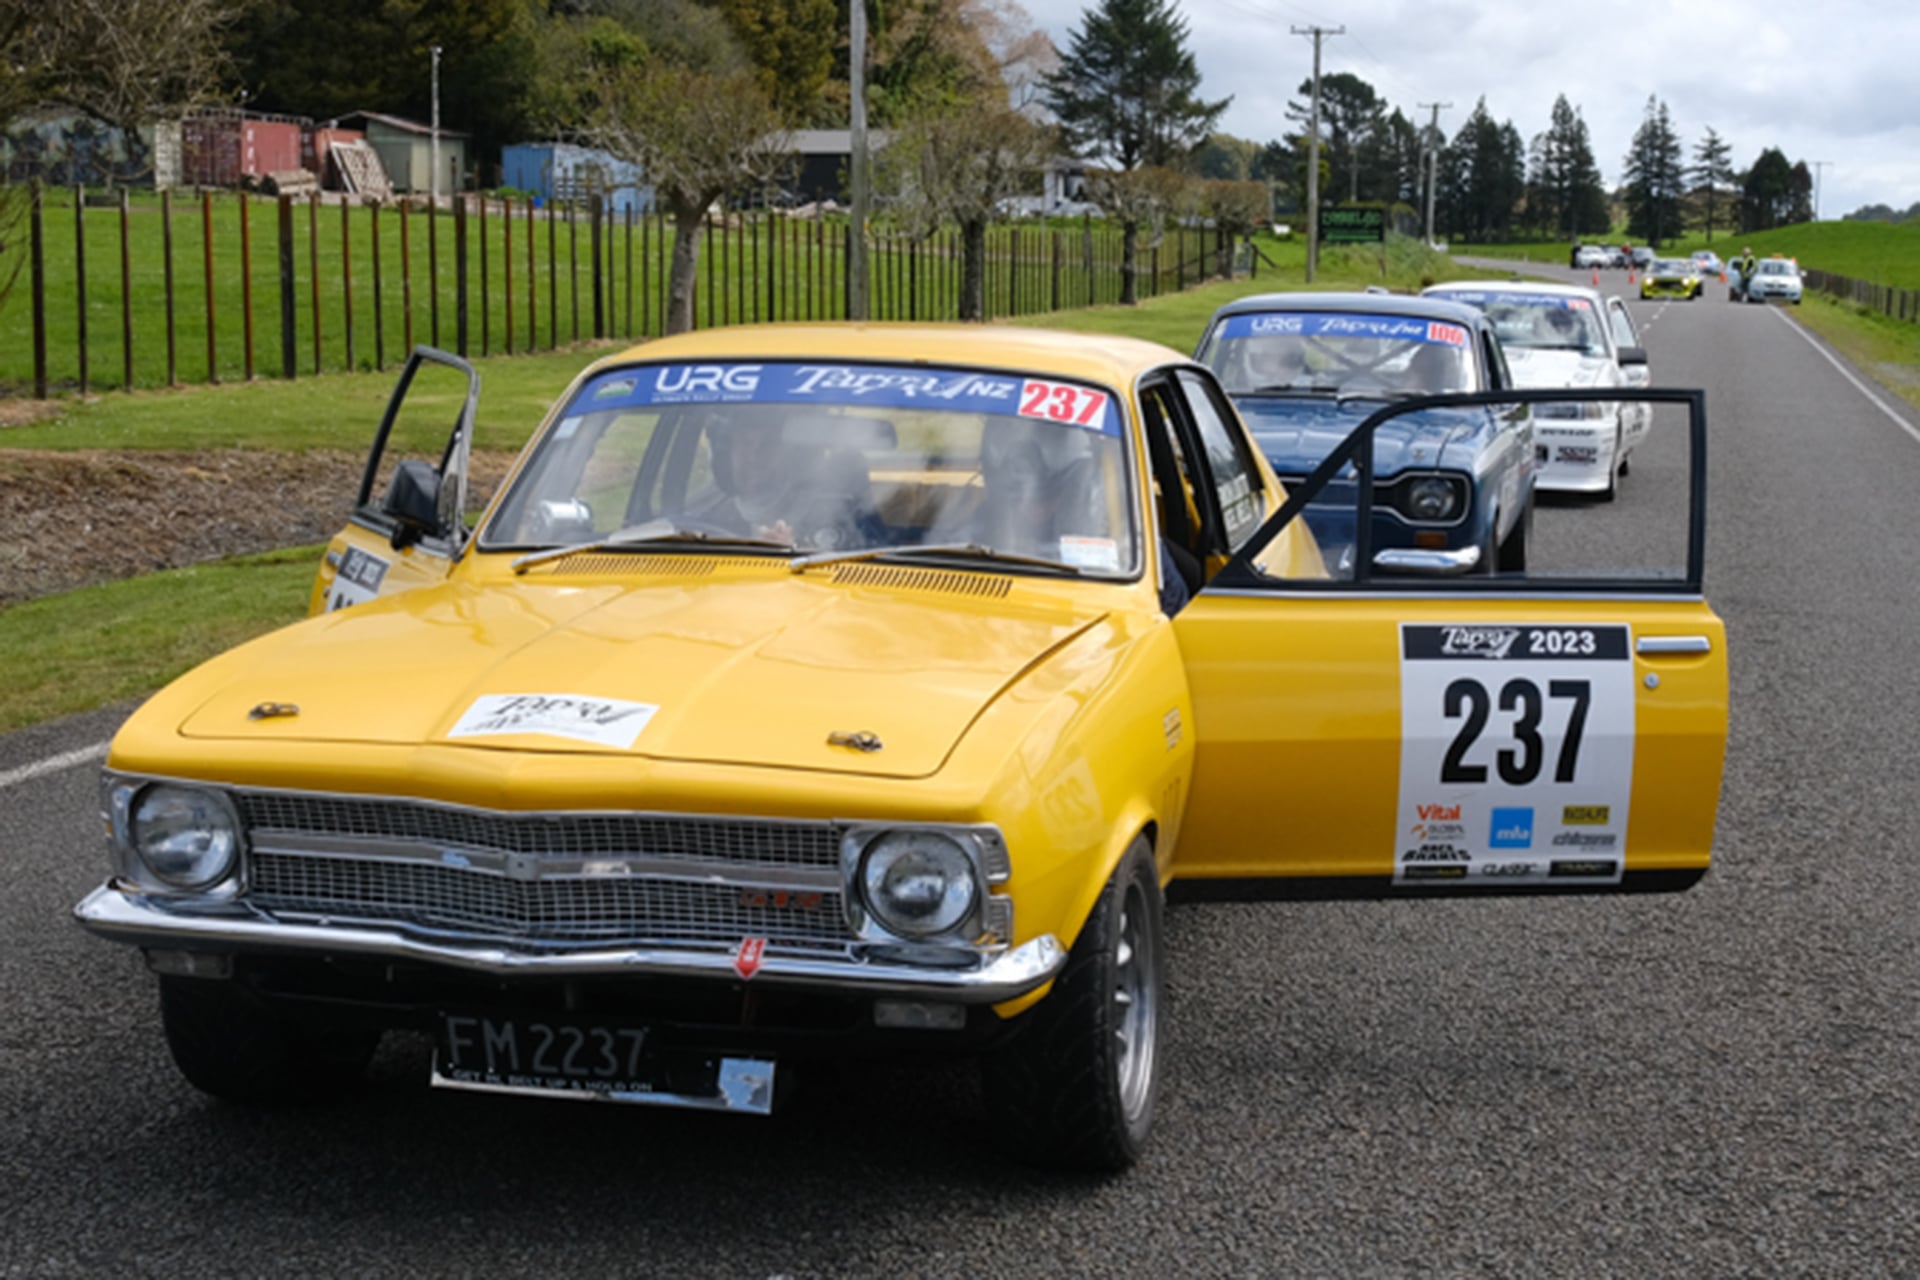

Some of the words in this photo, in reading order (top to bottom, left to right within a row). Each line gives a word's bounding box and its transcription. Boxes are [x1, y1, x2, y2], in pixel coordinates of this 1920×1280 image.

[1251, 317, 1302, 332] URG
[656, 365, 763, 392] URG
[967, 381, 1016, 399] NZ
[1020, 381, 1107, 425] 237
[1529, 630, 1597, 654] 2023
[1440, 677, 1591, 786] 237
[1416, 805, 1461, 821] Vital
[452, 1070, 481, 1082] GET
